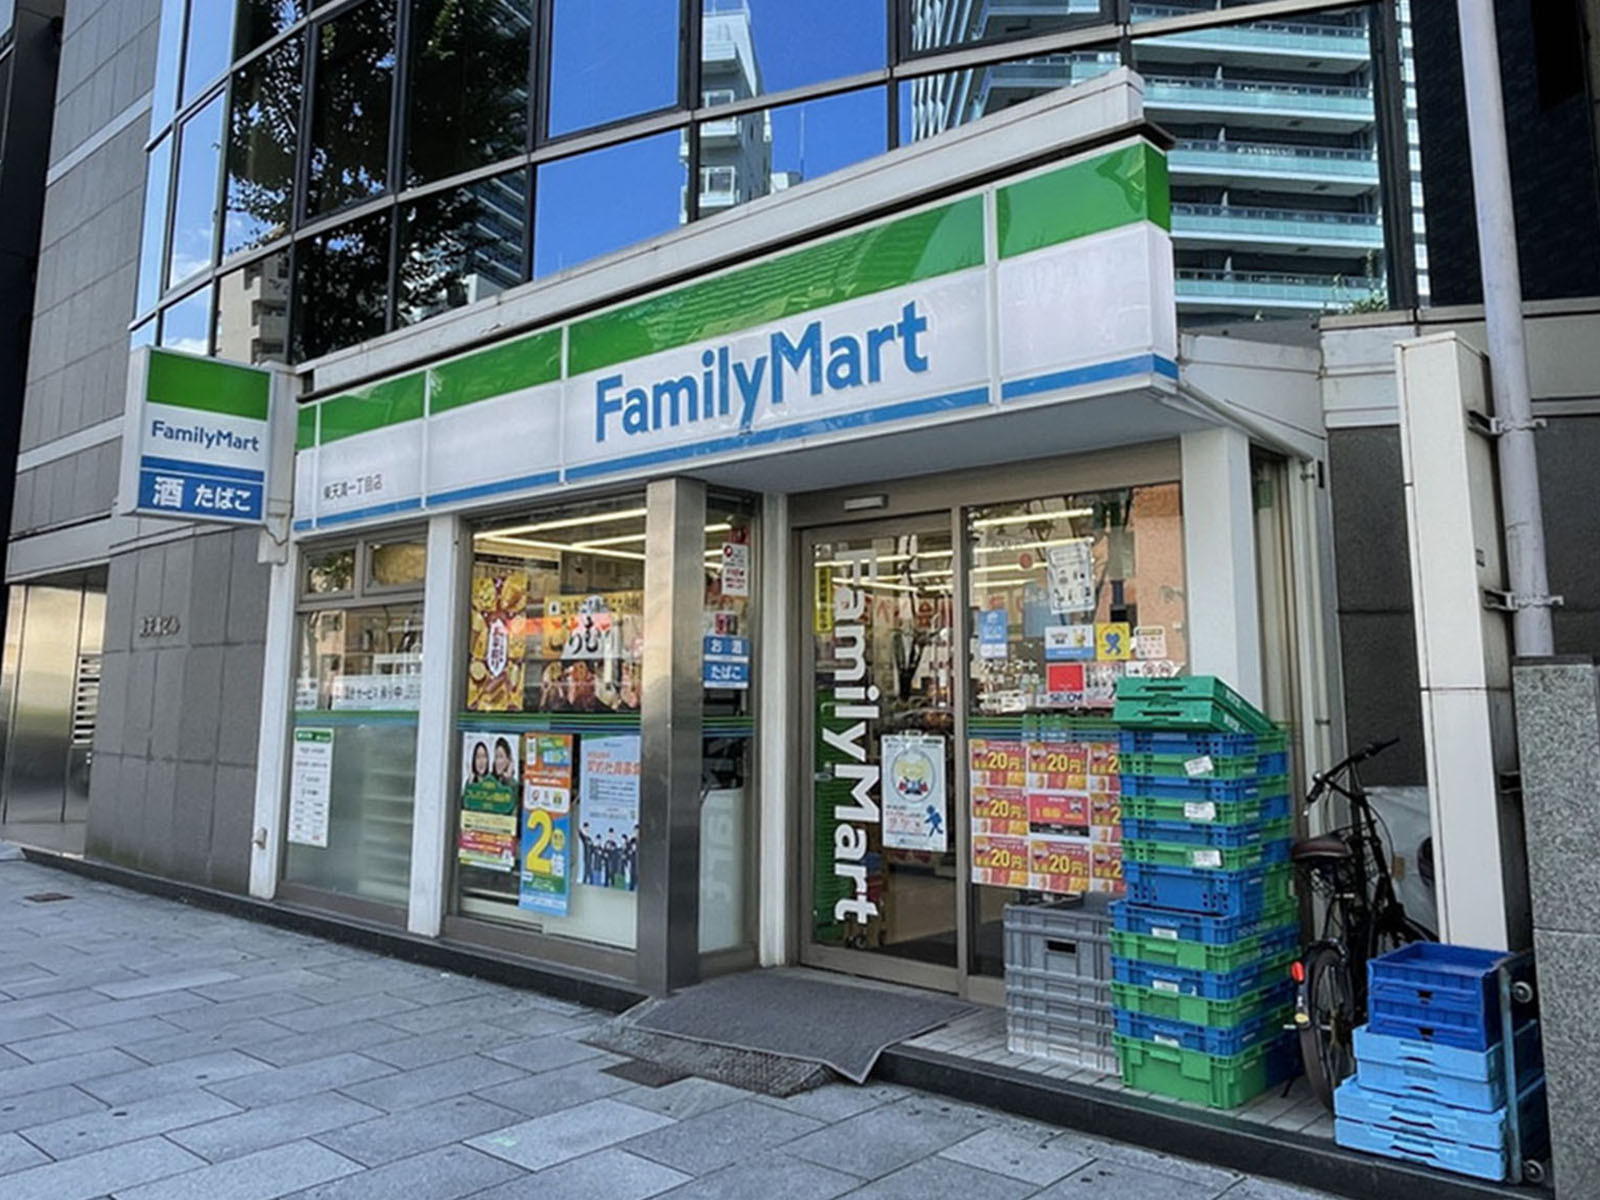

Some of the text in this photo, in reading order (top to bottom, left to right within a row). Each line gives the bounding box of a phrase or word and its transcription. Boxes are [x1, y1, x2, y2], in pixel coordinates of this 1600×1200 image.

[596, 300, 928, 443] FamilyMart
[151, 420, 260, 452] FamilyMart
[152, 476, 252, 512] 酒 たばこ
[711, 640, 743, 654] お酒
[711, 665, 742, 680] たばこ
[822, 549, 880, 925] FamilyMart
[1047, 754, 1081, 773] 20円
[1049, 854, 1084, 876] 20円
